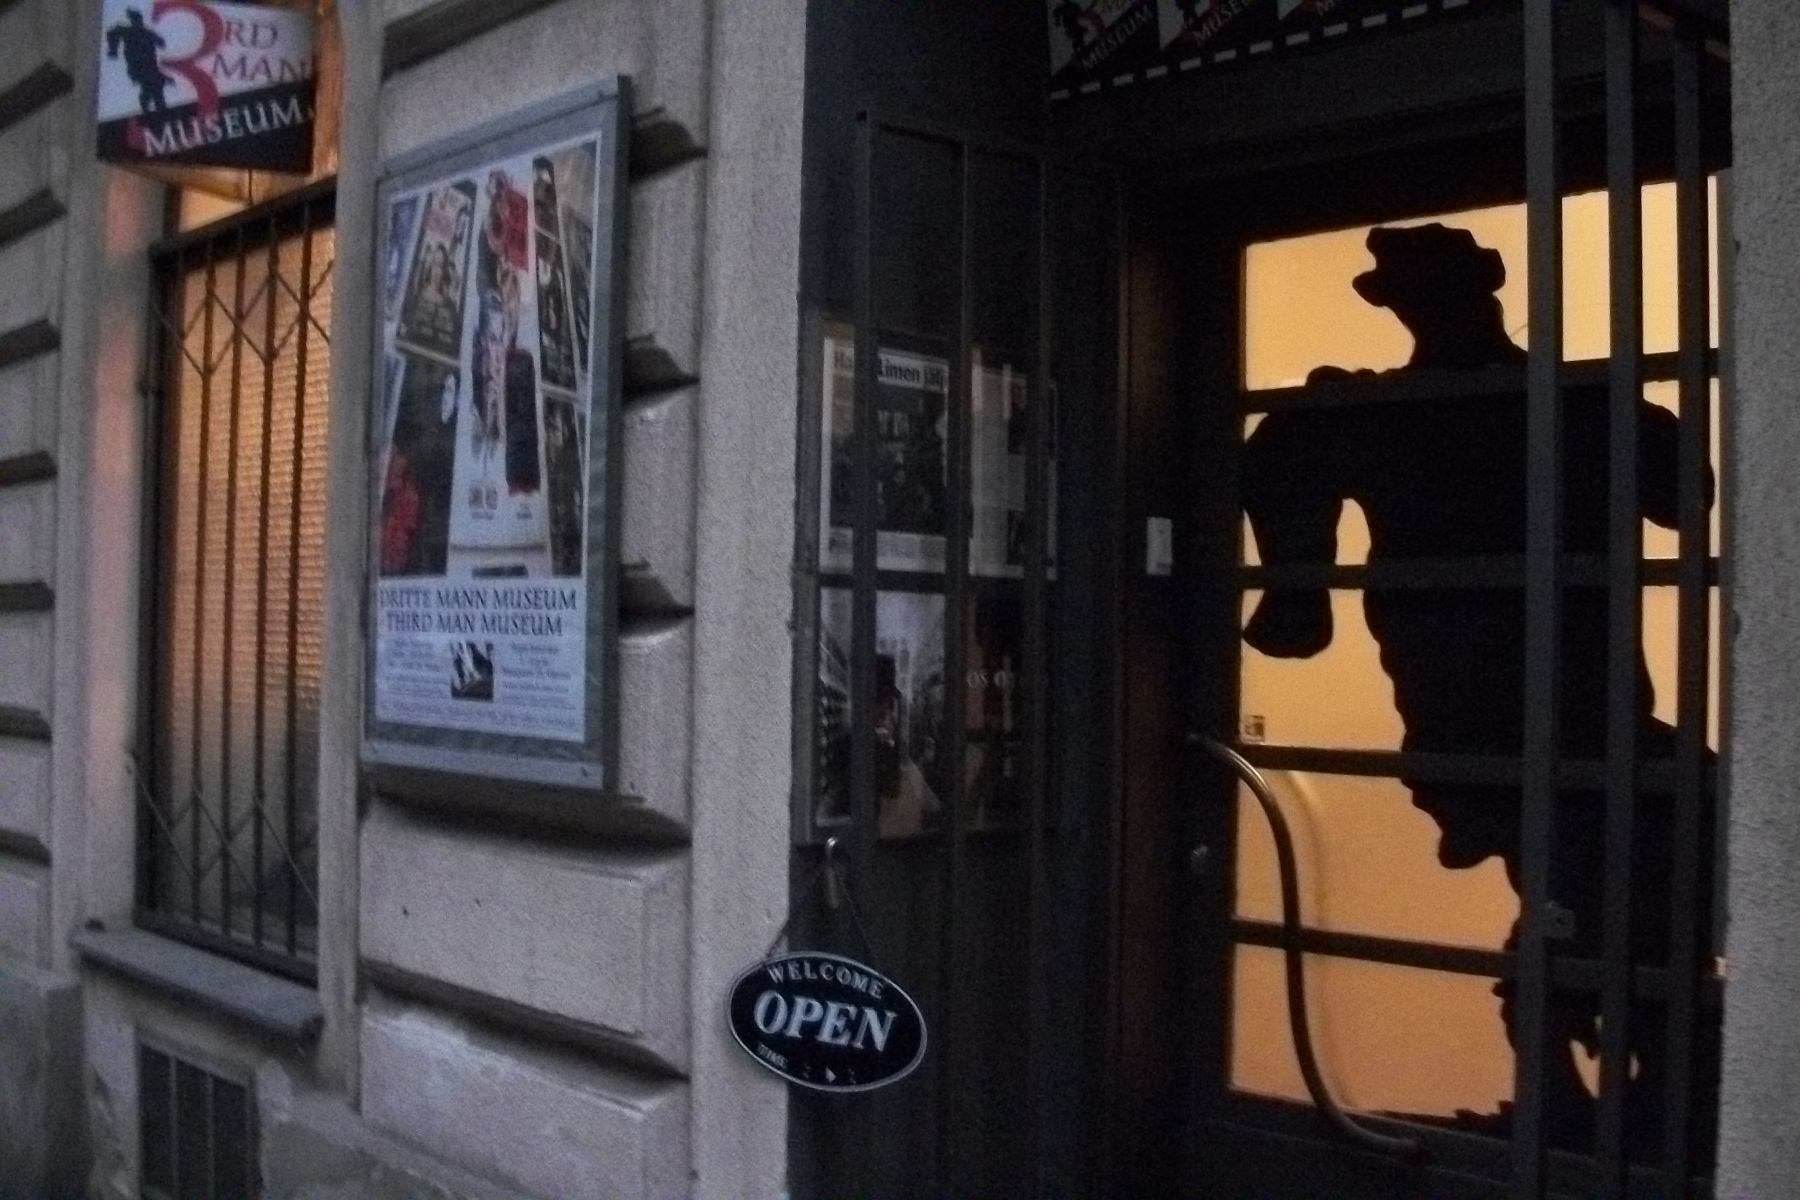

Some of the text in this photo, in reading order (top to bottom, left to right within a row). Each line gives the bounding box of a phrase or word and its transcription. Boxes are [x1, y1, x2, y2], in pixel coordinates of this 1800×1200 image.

[1081, 3, 1153, 71] MUSEUM
[212, 52, 308, 85] MAN
[142, 94, 304, 158] MUSEUM
[379, 586, 578, 612] DRITTE MANN MUSEUM
[386, 611, 564, 637] THIRD MAN MUSEUM
[765, 960, 886, 1001] WELCOME
[753, 988, 899, 1053] OPEN
